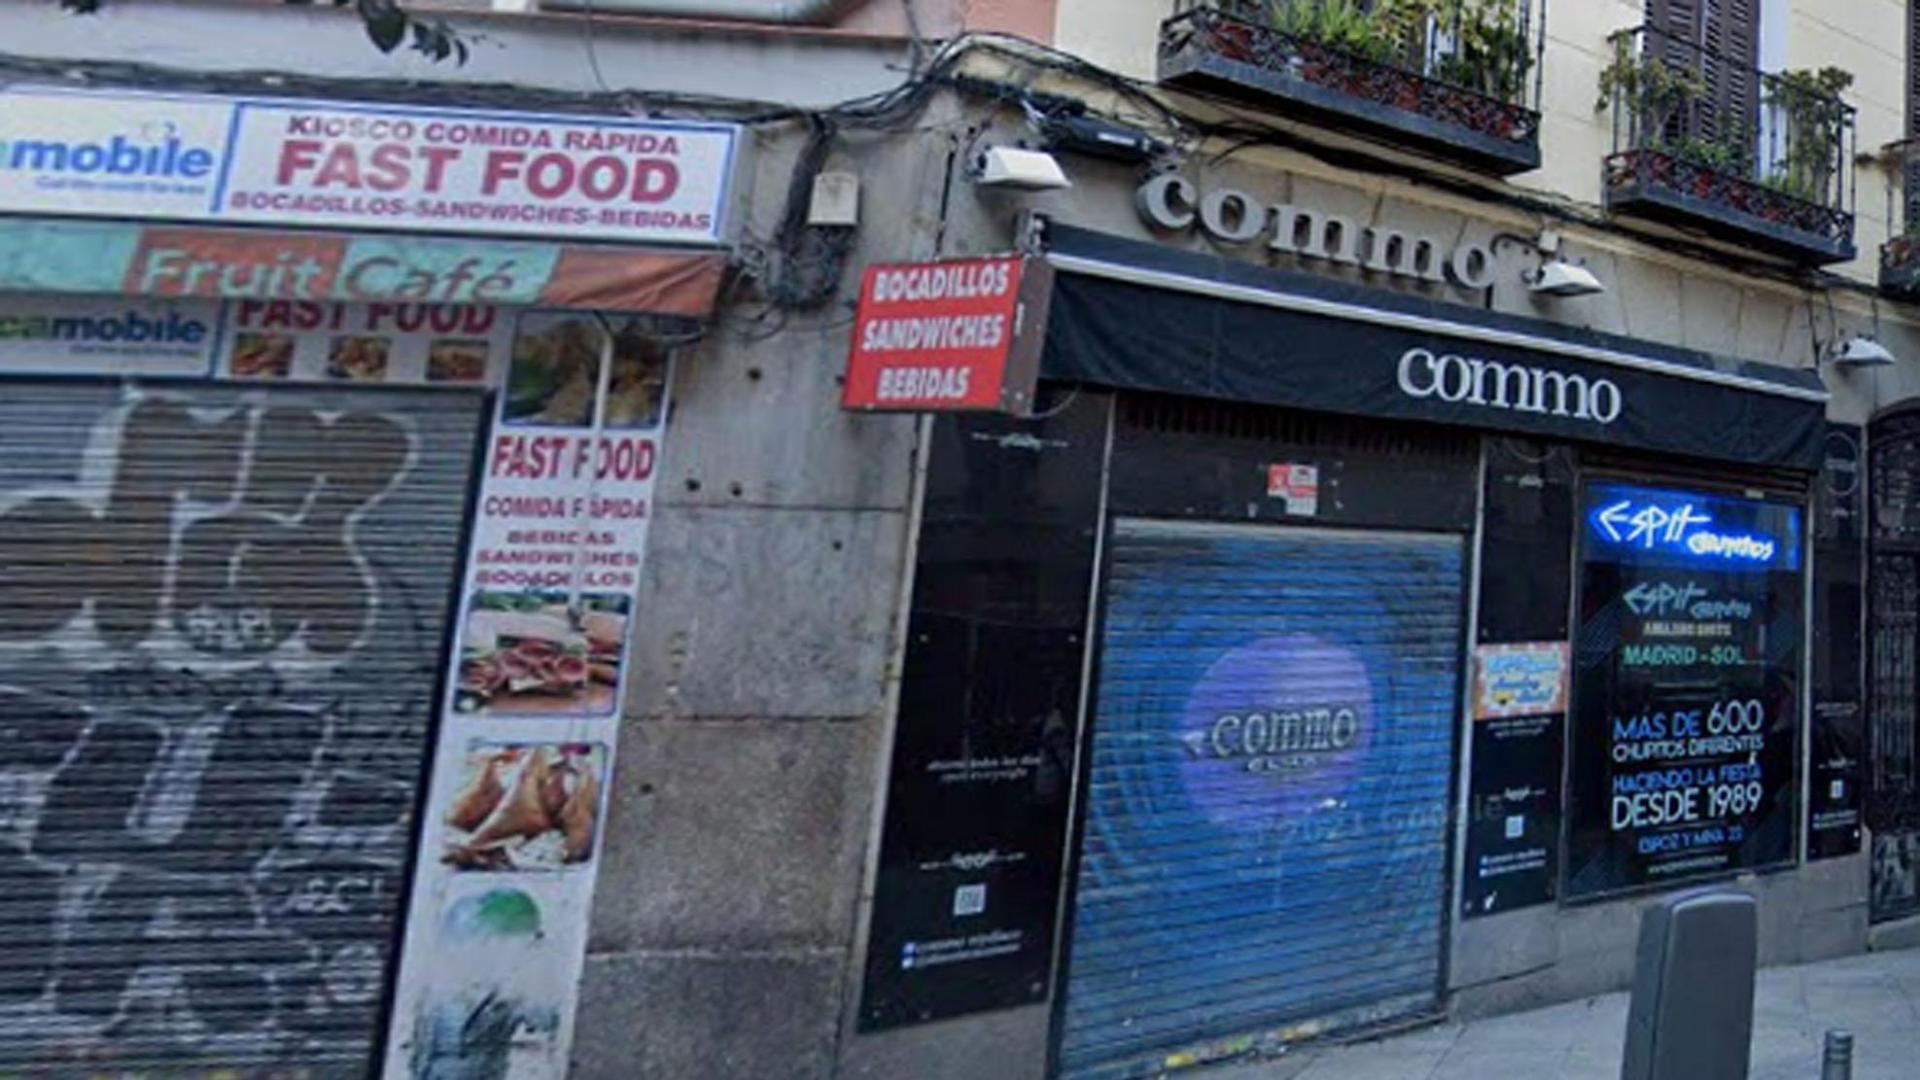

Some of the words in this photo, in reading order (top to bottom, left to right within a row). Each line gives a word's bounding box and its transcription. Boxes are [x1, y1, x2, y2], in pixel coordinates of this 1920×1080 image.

[287, 115, 415, 141] KIOSCO
[424, 123, 553, 148] COMIDA
[276, 139, 463, 193] FAST
[480, 150, 680, 204] FOOD
[1137, 172, 1497, 290] commo
[140, 248, 325, 298] Fruit
[345, 255, 516, 301] Café
[873, 262, 1010, 303] BOCADILLOS
[862, 314, 1005, 351] SANDWICHES
[876, 366, 971, 401] BEBIDAS
[1398, 347, 1622, 424] commo
[491, 435, 568, 479] FAST
[1622, 644, 1697, 666] MADRID
[1212, 706, 1358, 758] commo
[1672, 710, 1701, 738] DE
[1707, 699, 1765, 734] 600
[1697, 768, 1716, 786] LA
[1611, 786, 1700, 832] DESDE
[1708, 781, 1763, 819] 1989
